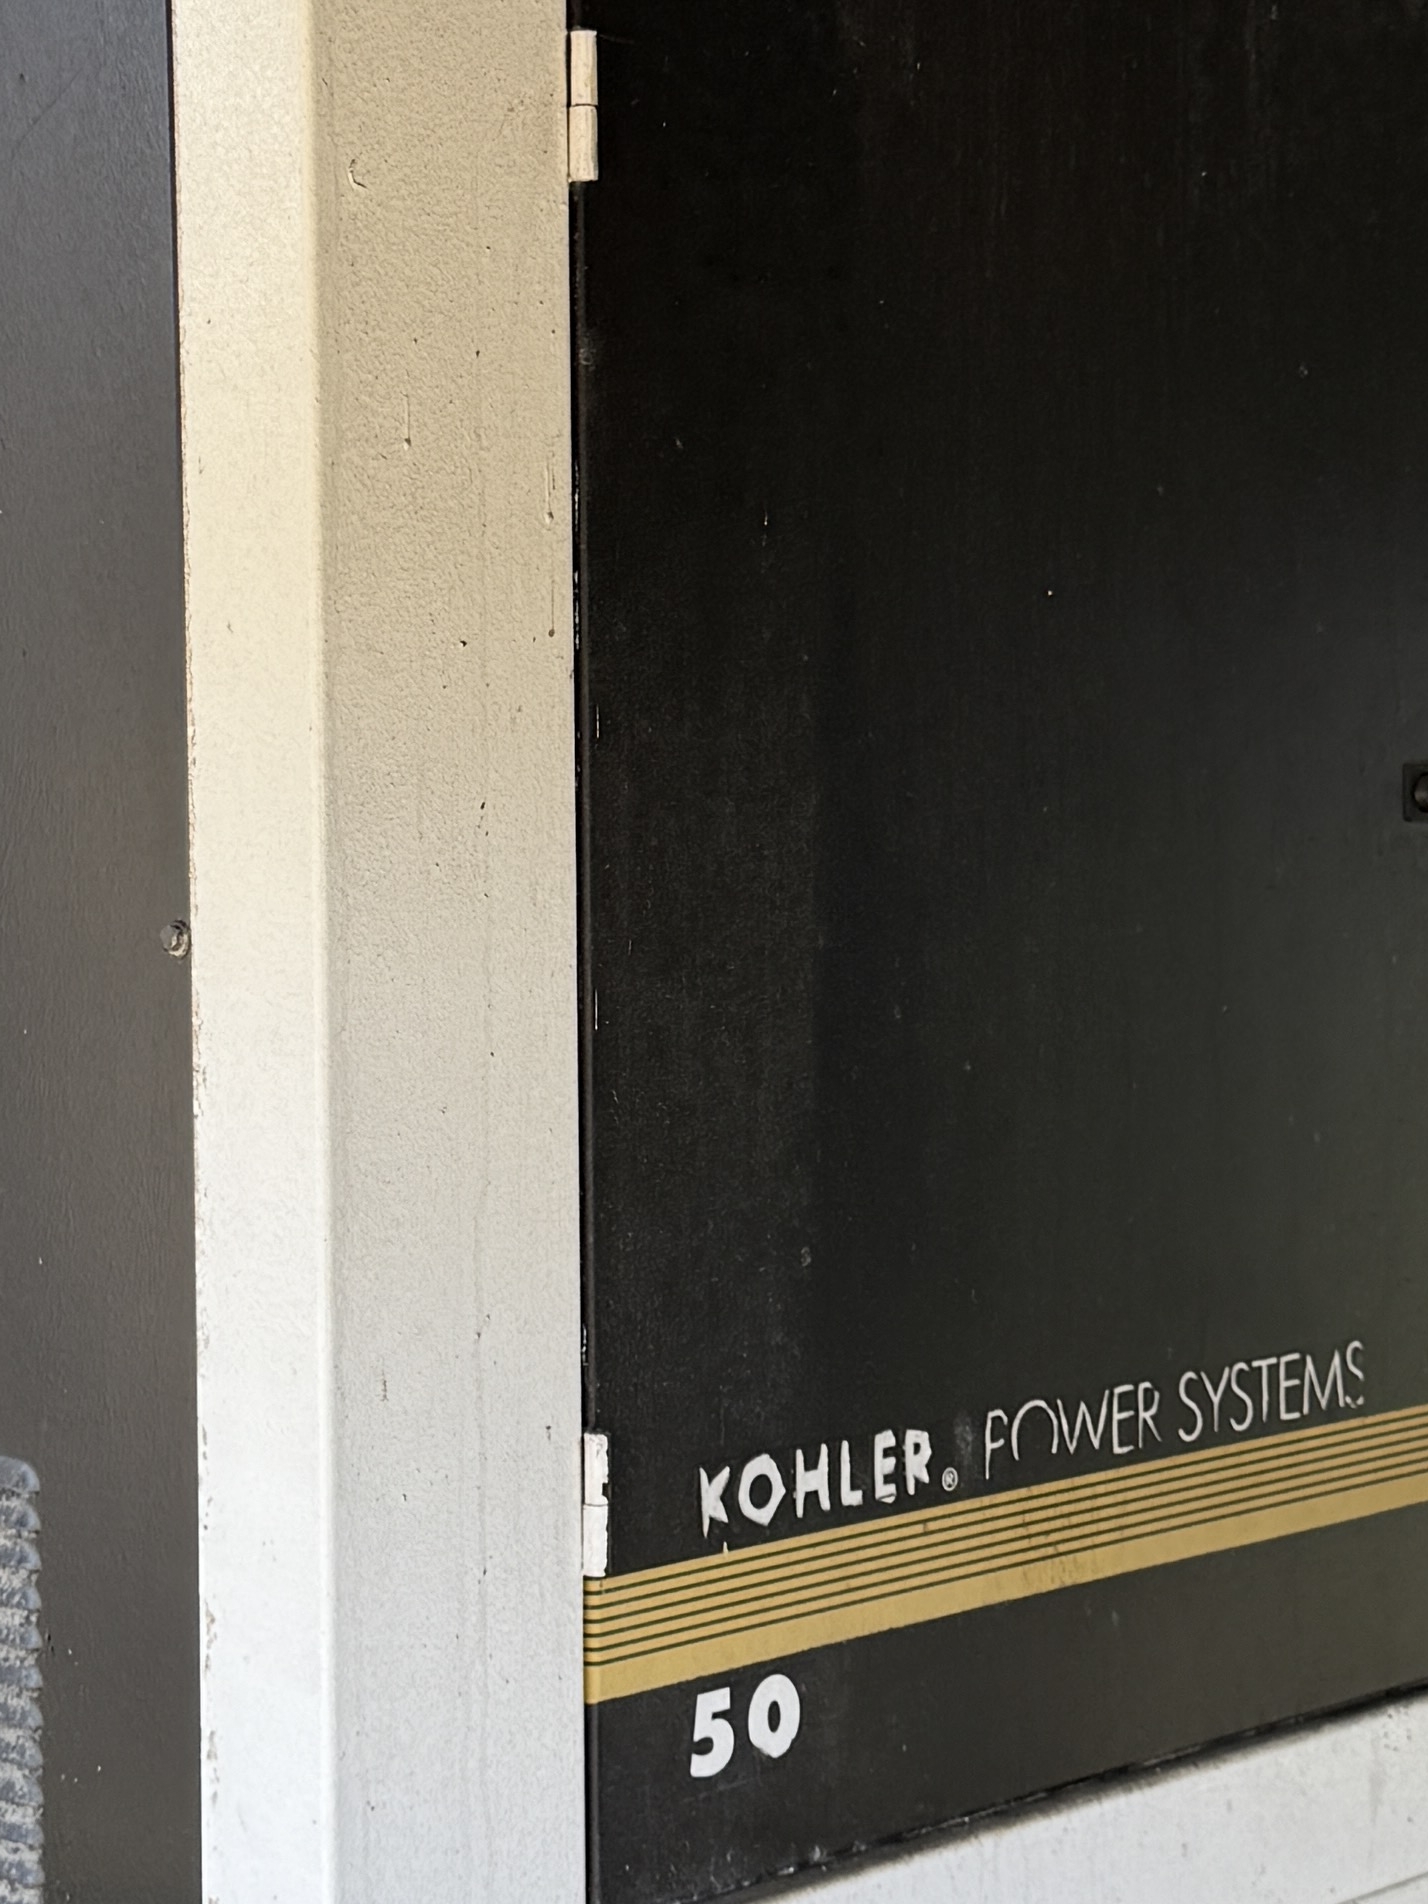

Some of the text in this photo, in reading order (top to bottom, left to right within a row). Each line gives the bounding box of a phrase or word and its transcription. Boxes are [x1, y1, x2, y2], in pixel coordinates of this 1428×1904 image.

[984, 1381, 1163, 1481] POWER
[1177, 1339, 1365, 1444] SYSTEMS
[689, 1673, 801, 1778] 50
